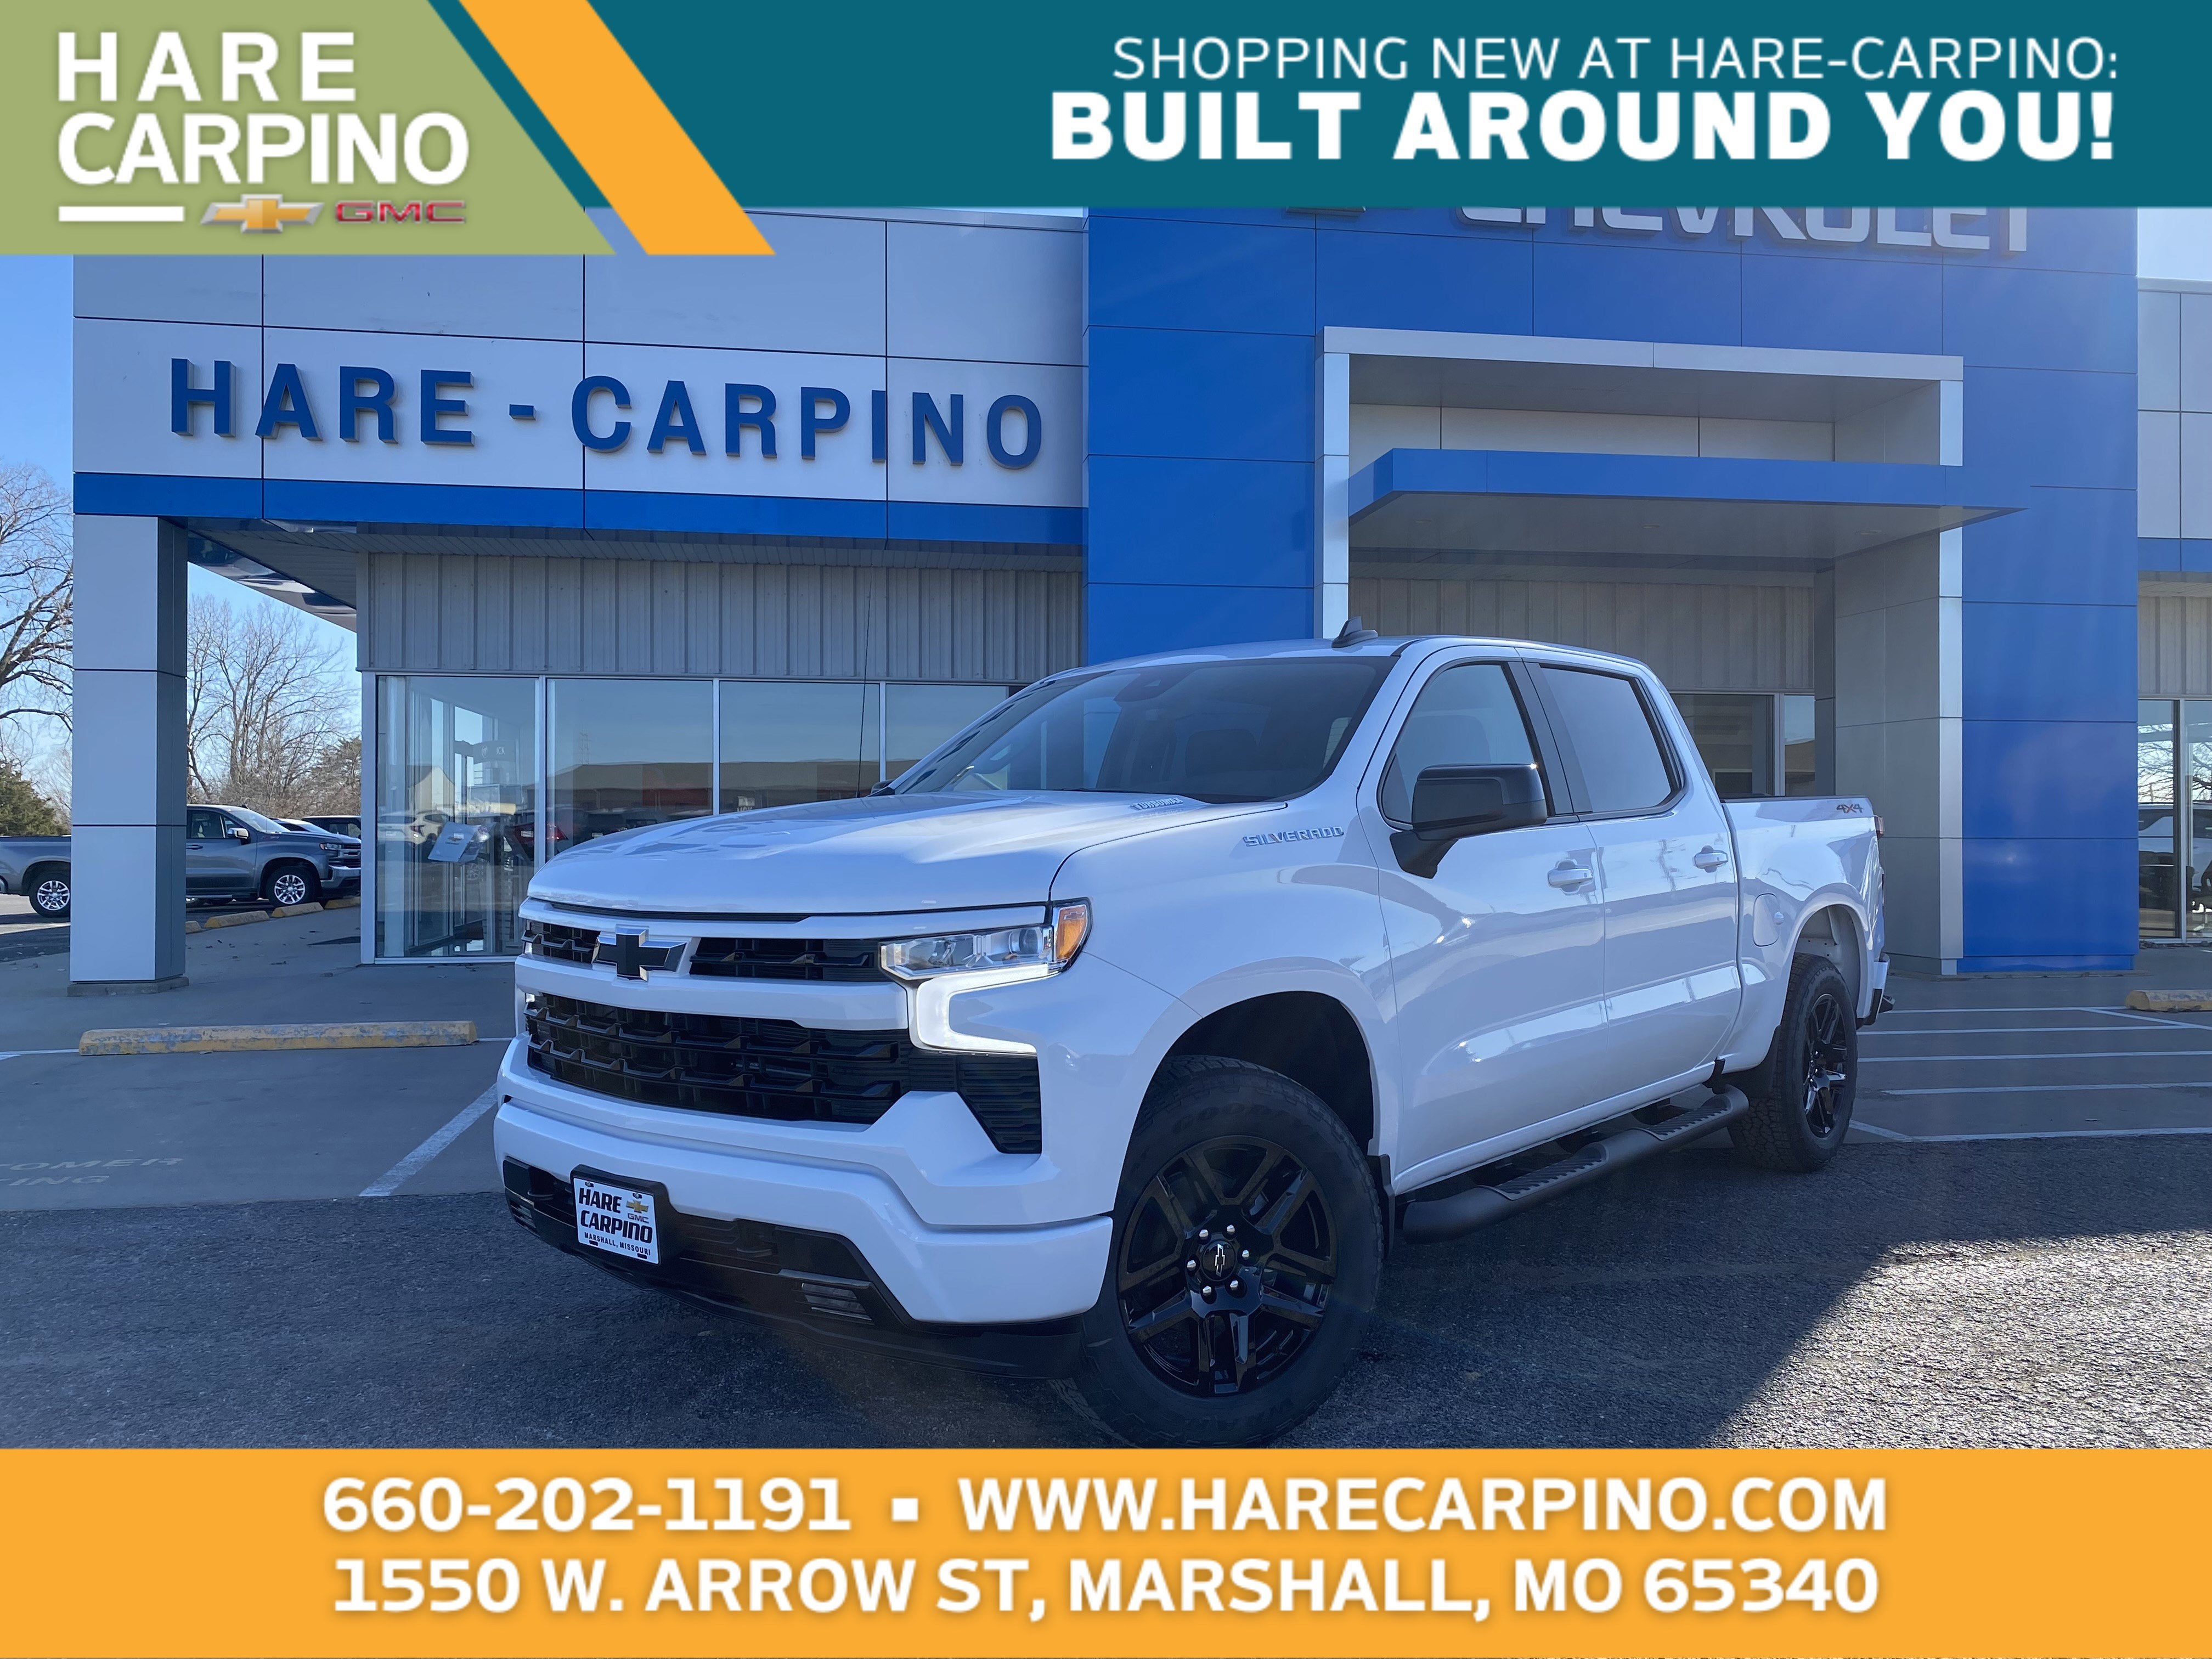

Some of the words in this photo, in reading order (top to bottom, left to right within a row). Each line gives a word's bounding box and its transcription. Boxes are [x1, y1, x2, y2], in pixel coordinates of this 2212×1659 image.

[171, 358, 475, 447] HARE
[571, 375, 1042, 471] CARPINO
[1243, 826, 1344, 847] SILVERADO
[578, 1187, 622, 1214] HARE
[580, 1210, 653, 1244] CARPINO
[627, 1213, 650, 1224] GMC
[584, 1232, 618, 1249] MARSHALL,
[619, 1241, 651, 1256] MISSOURI
